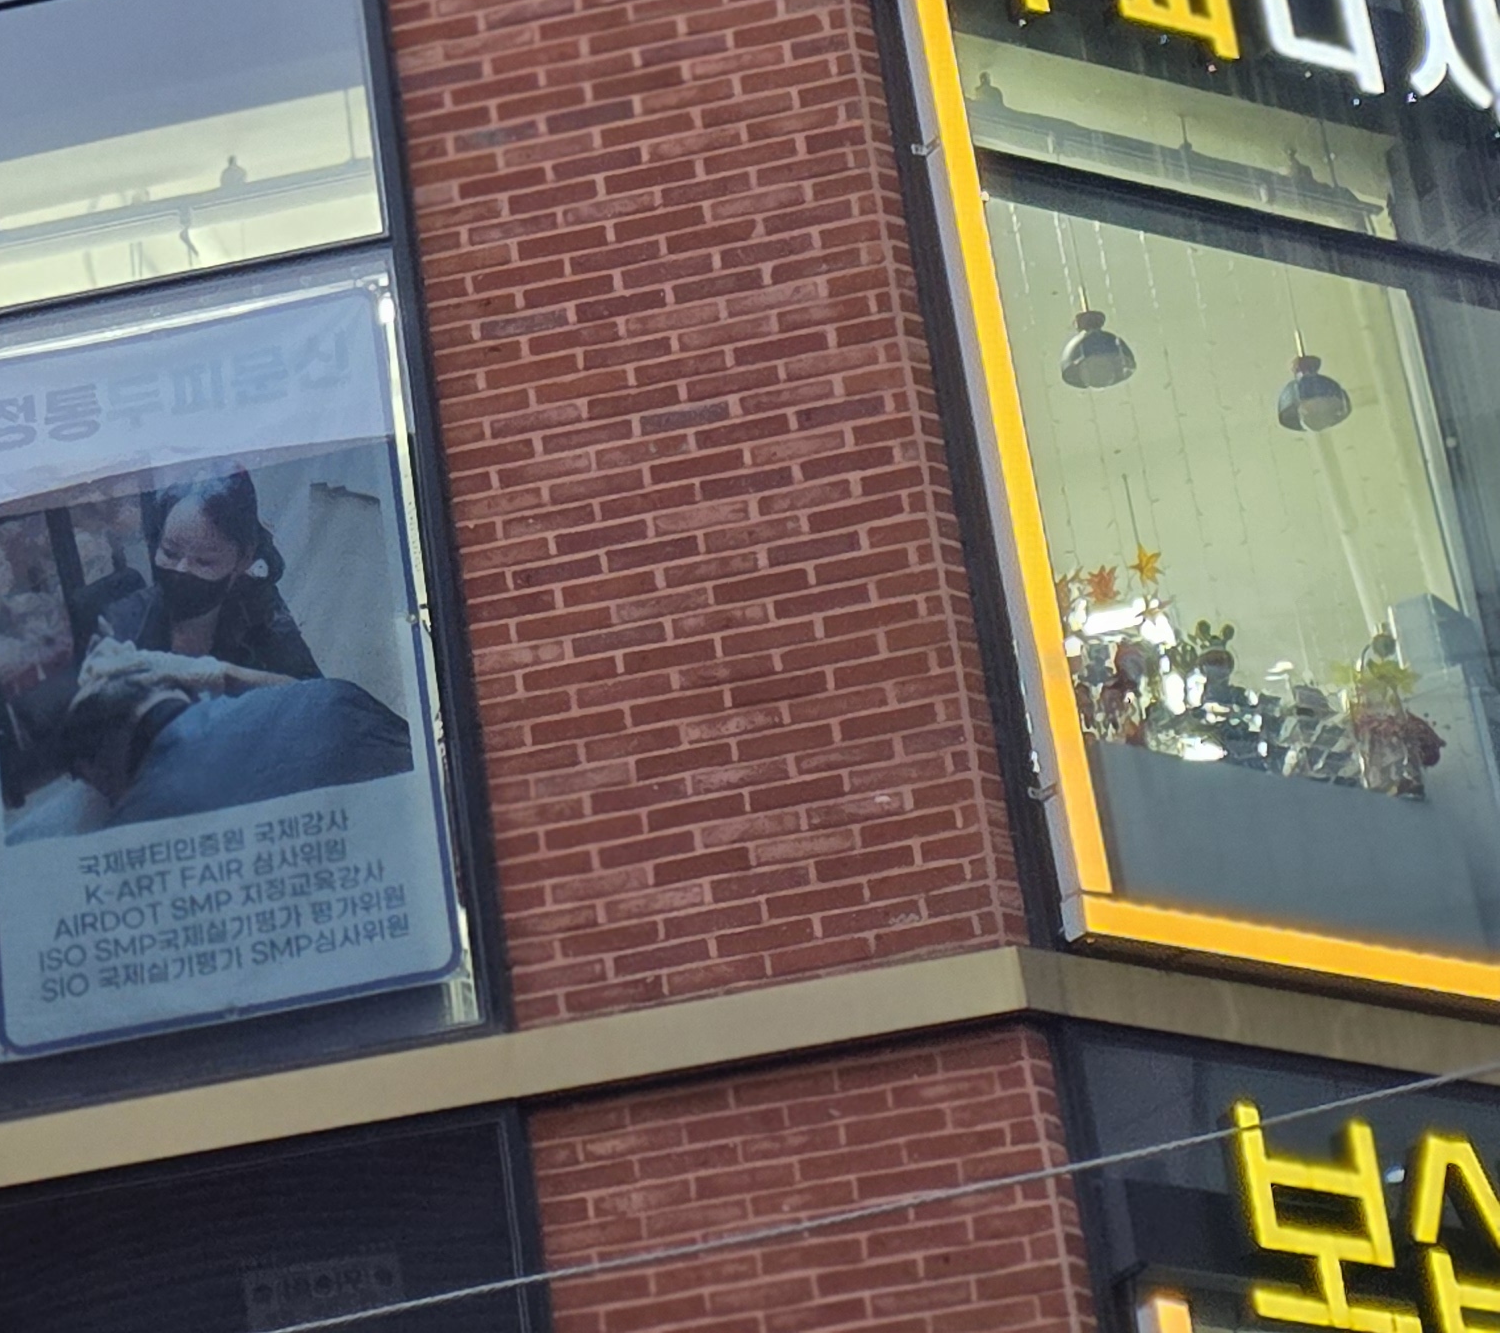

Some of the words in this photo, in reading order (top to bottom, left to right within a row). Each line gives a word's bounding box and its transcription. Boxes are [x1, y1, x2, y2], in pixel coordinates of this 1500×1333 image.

[78, 827, 245, 877] 국제뷰티인증원
[254, 807, 349, 846] 국제강사
[84, 870, 172, 905] K-ART
[180, 858, 244, 889] FAIR
[253, 837, 348, 877] 심사위원
[38, 943, 88, 973] ISO
[94, 904, 303, 963] SMP국제실기평가
[310, 884, 407, 926] 평가위원
[53, 900, 162, 941] AIRDOT
[170, 889, 233, 923] SMP
[241, 858, 386, 907] 지정교육강사
[40, 972, 90, 1004] SIO
[99, 945, 244, 992] 국제실기평가
[251, 913, 411, 967] SMP심사위원
